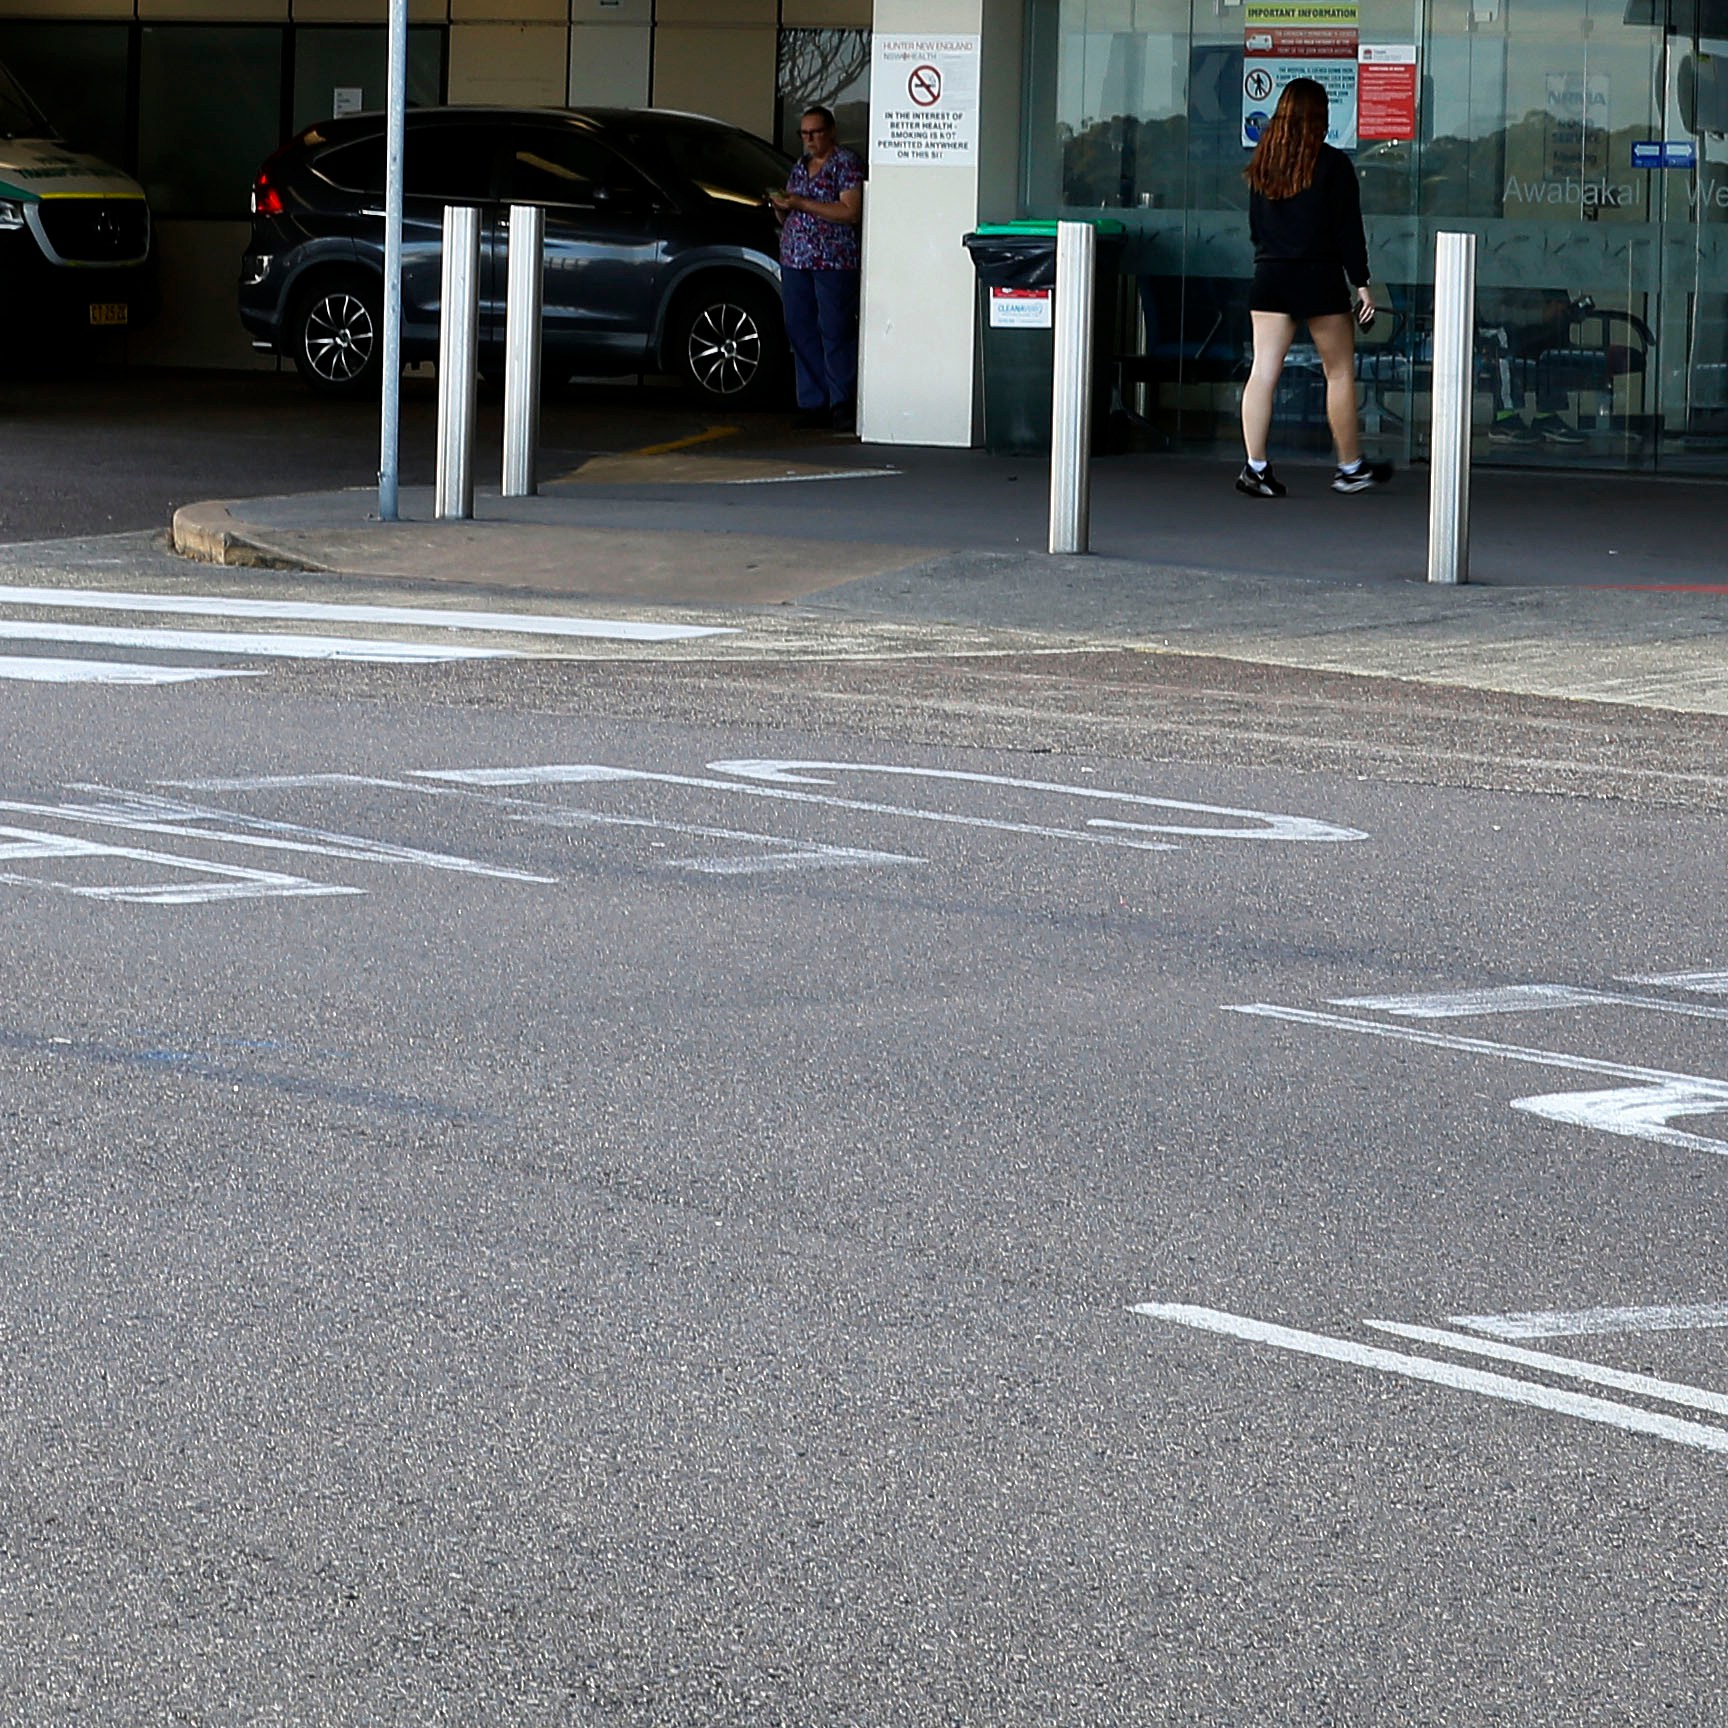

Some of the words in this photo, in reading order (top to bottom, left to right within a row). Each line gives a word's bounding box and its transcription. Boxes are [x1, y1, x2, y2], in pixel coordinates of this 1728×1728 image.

[1248, 8, 1295, 18] IMPORTANT
[1298, 8, 1356, 18] INFORMATION
[883, 41, 915, 50] HUNTER
[916, 42, 935, 51] NEW
[936, 42, 973, 51] ENGLAND
[885, 111, 893, 119] IN
[895, 111, 911, 119] THE
[912, 111, 950, 120] INTEREST
[952, 112, 964, 120] OF
[890, 121, 921, 129] BETTER
[922, 121, 953, 130] HEALTH
[891, 131, 928, 140] SMOKING
[930, 131, 938, 140] IS
[877, 140, 923, 149] PERMITTED
[925, 141, 969, 150] ANYWHERE
[897, 151, 909, 159] ON
[911, 151, 930, 160] THIS
[1502, 175, 1641, 206] Awabakal
